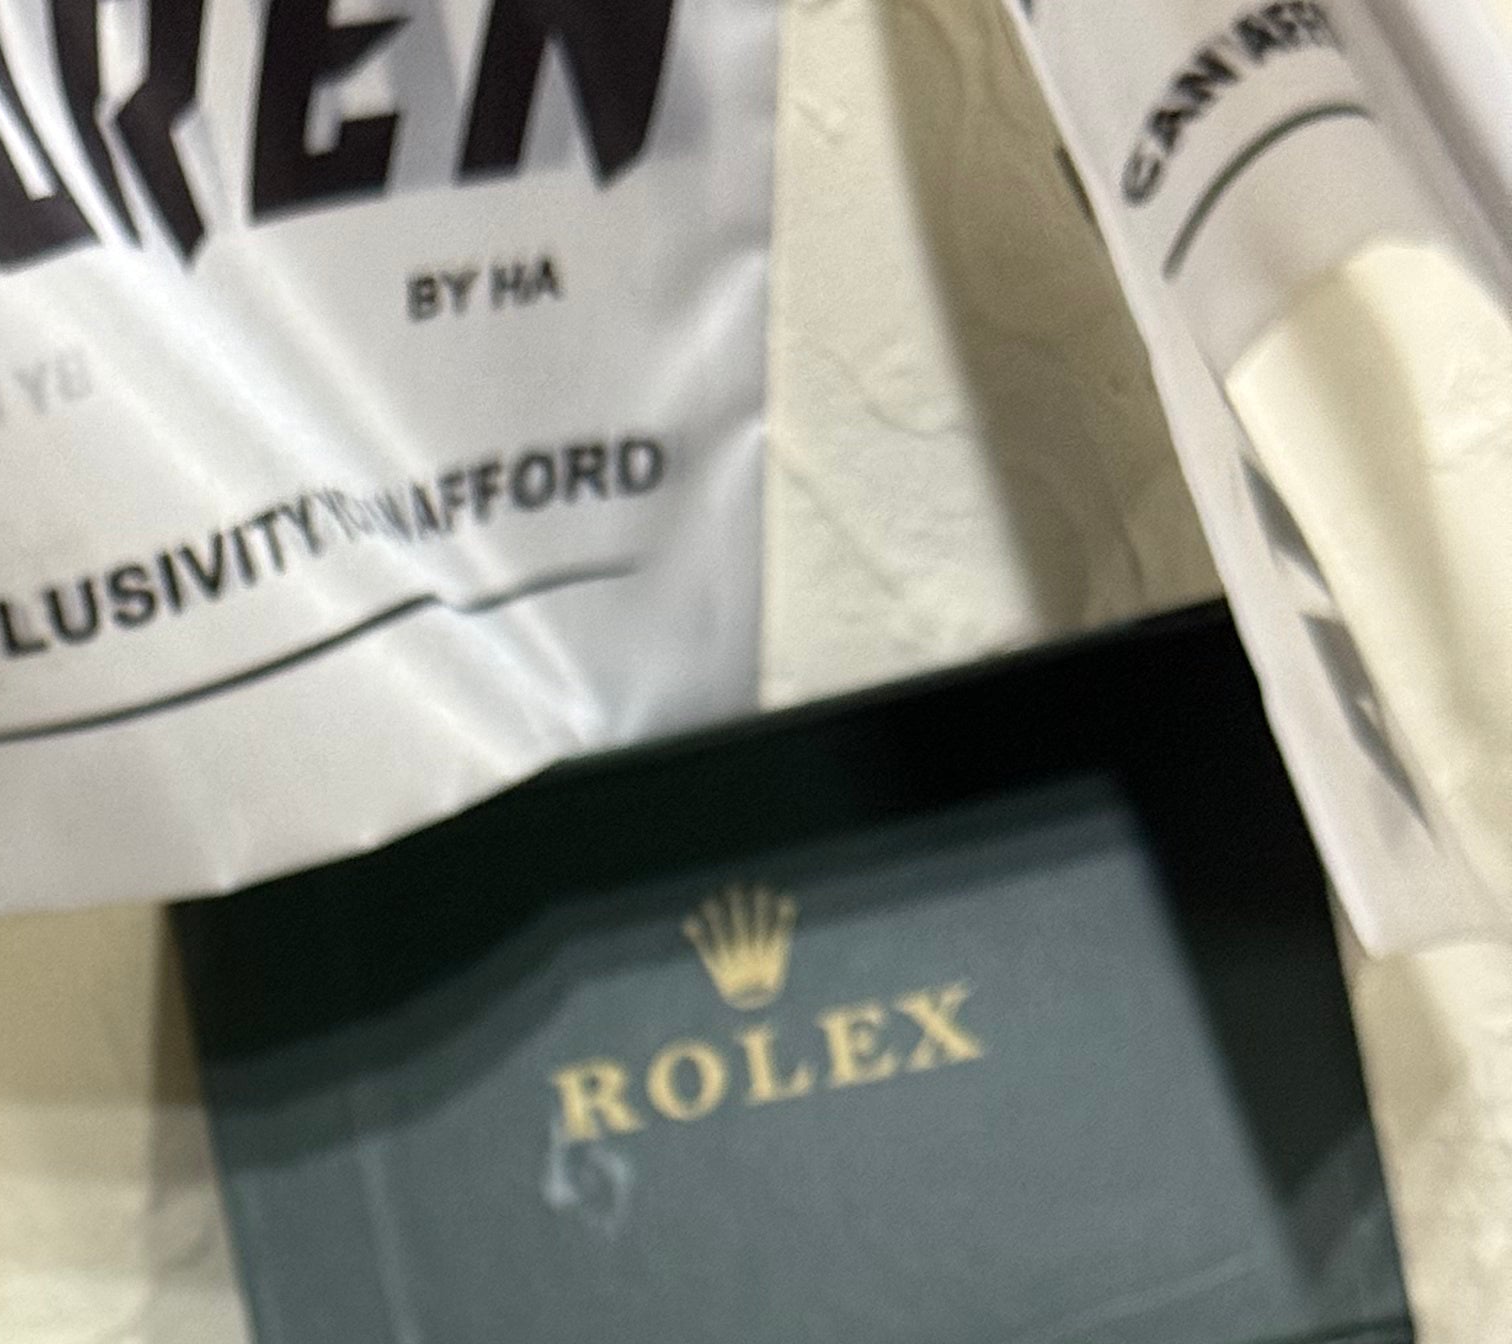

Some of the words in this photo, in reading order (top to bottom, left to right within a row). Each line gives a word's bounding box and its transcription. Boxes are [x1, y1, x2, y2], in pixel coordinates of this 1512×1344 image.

[405, 267, 481, 324] BY
[489, 256, 565, 310] HA
[550, 982, 985, 1142] ROLEX
